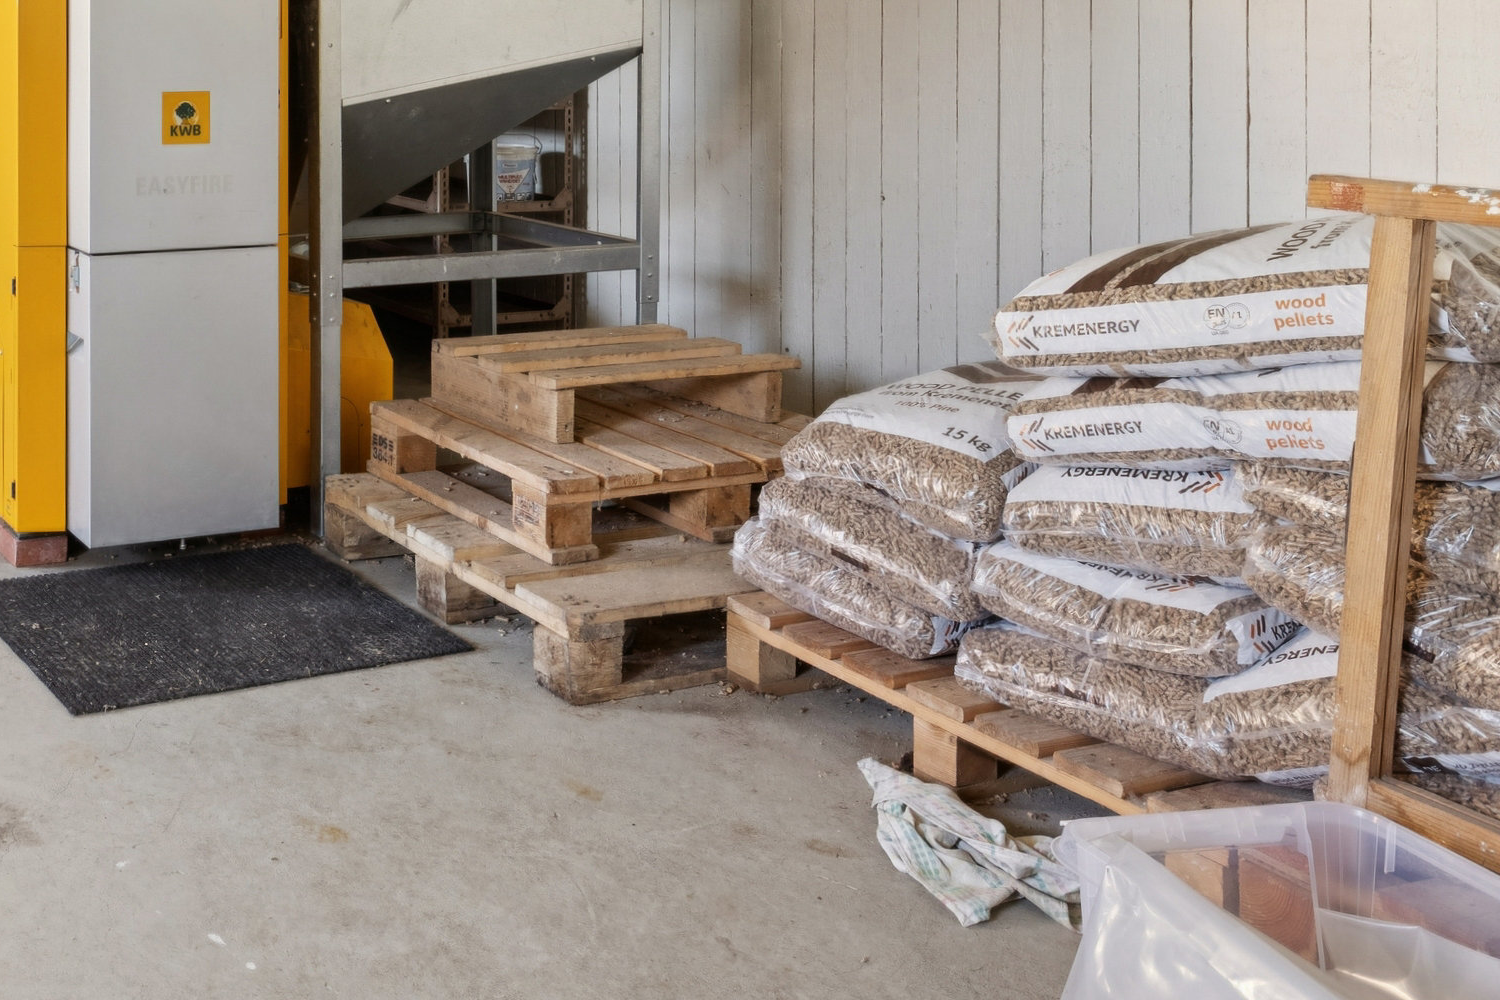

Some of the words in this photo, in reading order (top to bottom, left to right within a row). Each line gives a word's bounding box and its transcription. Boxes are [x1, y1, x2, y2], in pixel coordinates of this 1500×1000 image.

[170, 124, 202, 137] KWB
[136, 175, 234, 196] EASYFIRE
[1266, 222, 1327, 262] WOOD
[1275, 292, 1326, 310] wood
[1032, 319, 1140, 338] KREMENERGY
[1273, 312, 1334, 331] pellets
[894, 400, 926, 409] 100%
[929, 403, 960, 413] Pine
[1043, 420, 1143, 440] KREMENERGY
[1265, 417, 1313, 432] wood
[942, 427, 969, 440] 15
[967, 435, 992, 453] kg
[1265, 434, 1325, 451] pellets
[1061, 467, 1189, 483] KREMENERGY
